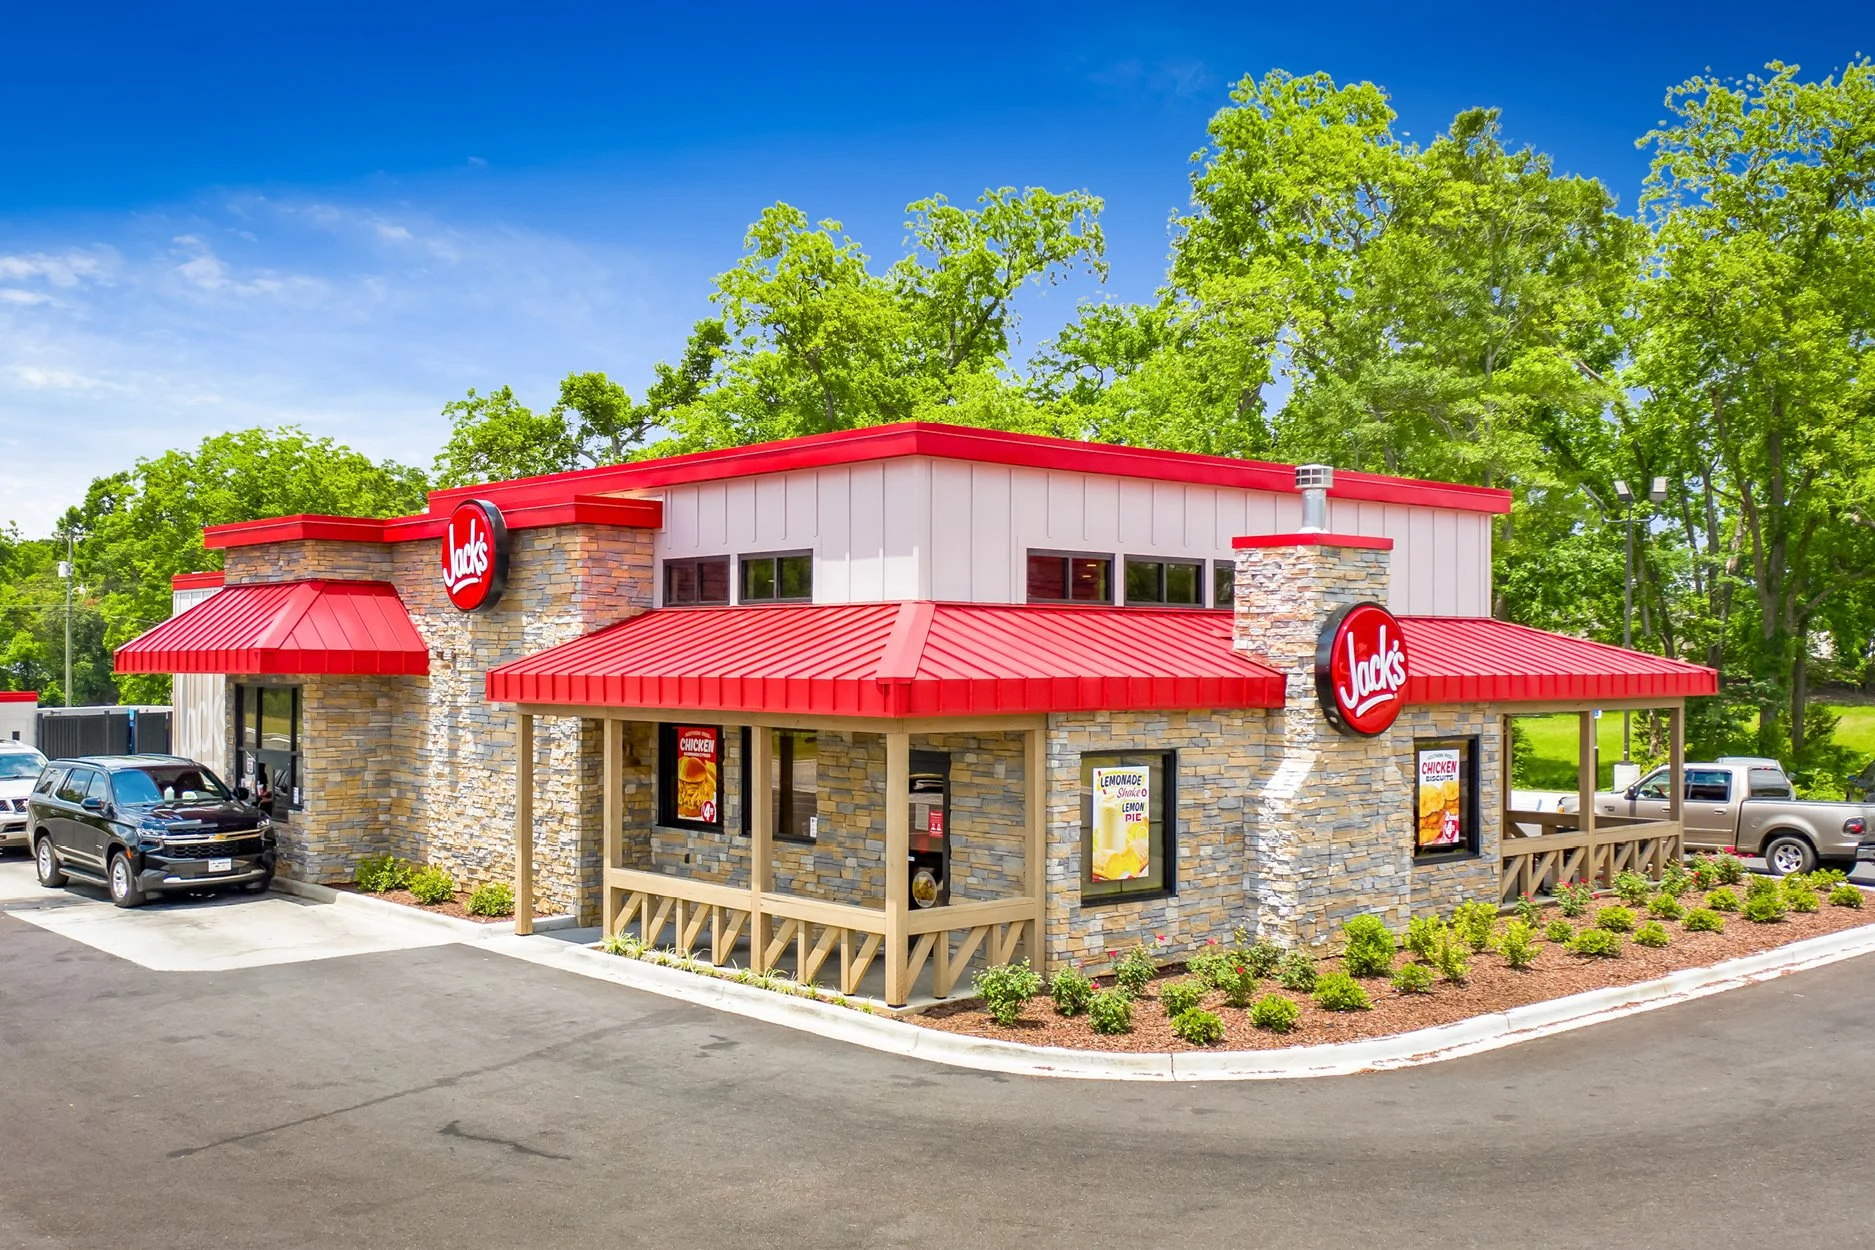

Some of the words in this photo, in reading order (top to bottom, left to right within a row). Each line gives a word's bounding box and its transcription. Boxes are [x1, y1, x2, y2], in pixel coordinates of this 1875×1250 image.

[443, 519, 488, 588] Jack's
[1340, 624, 1406, 710] Jack's
[680, 737, 715, 753] CHICKEN
[1421, 760, 1457, 775] CHICKEN
[1100, 774, 1142, 788] LEMONADE
[1426, 774, 1453, 782] BISCUITS
[1116, 787, 1140, 798] Shake
[1122, 802, 1145, 813] LEMON
[1125, 813, 1142, 822] PIE
